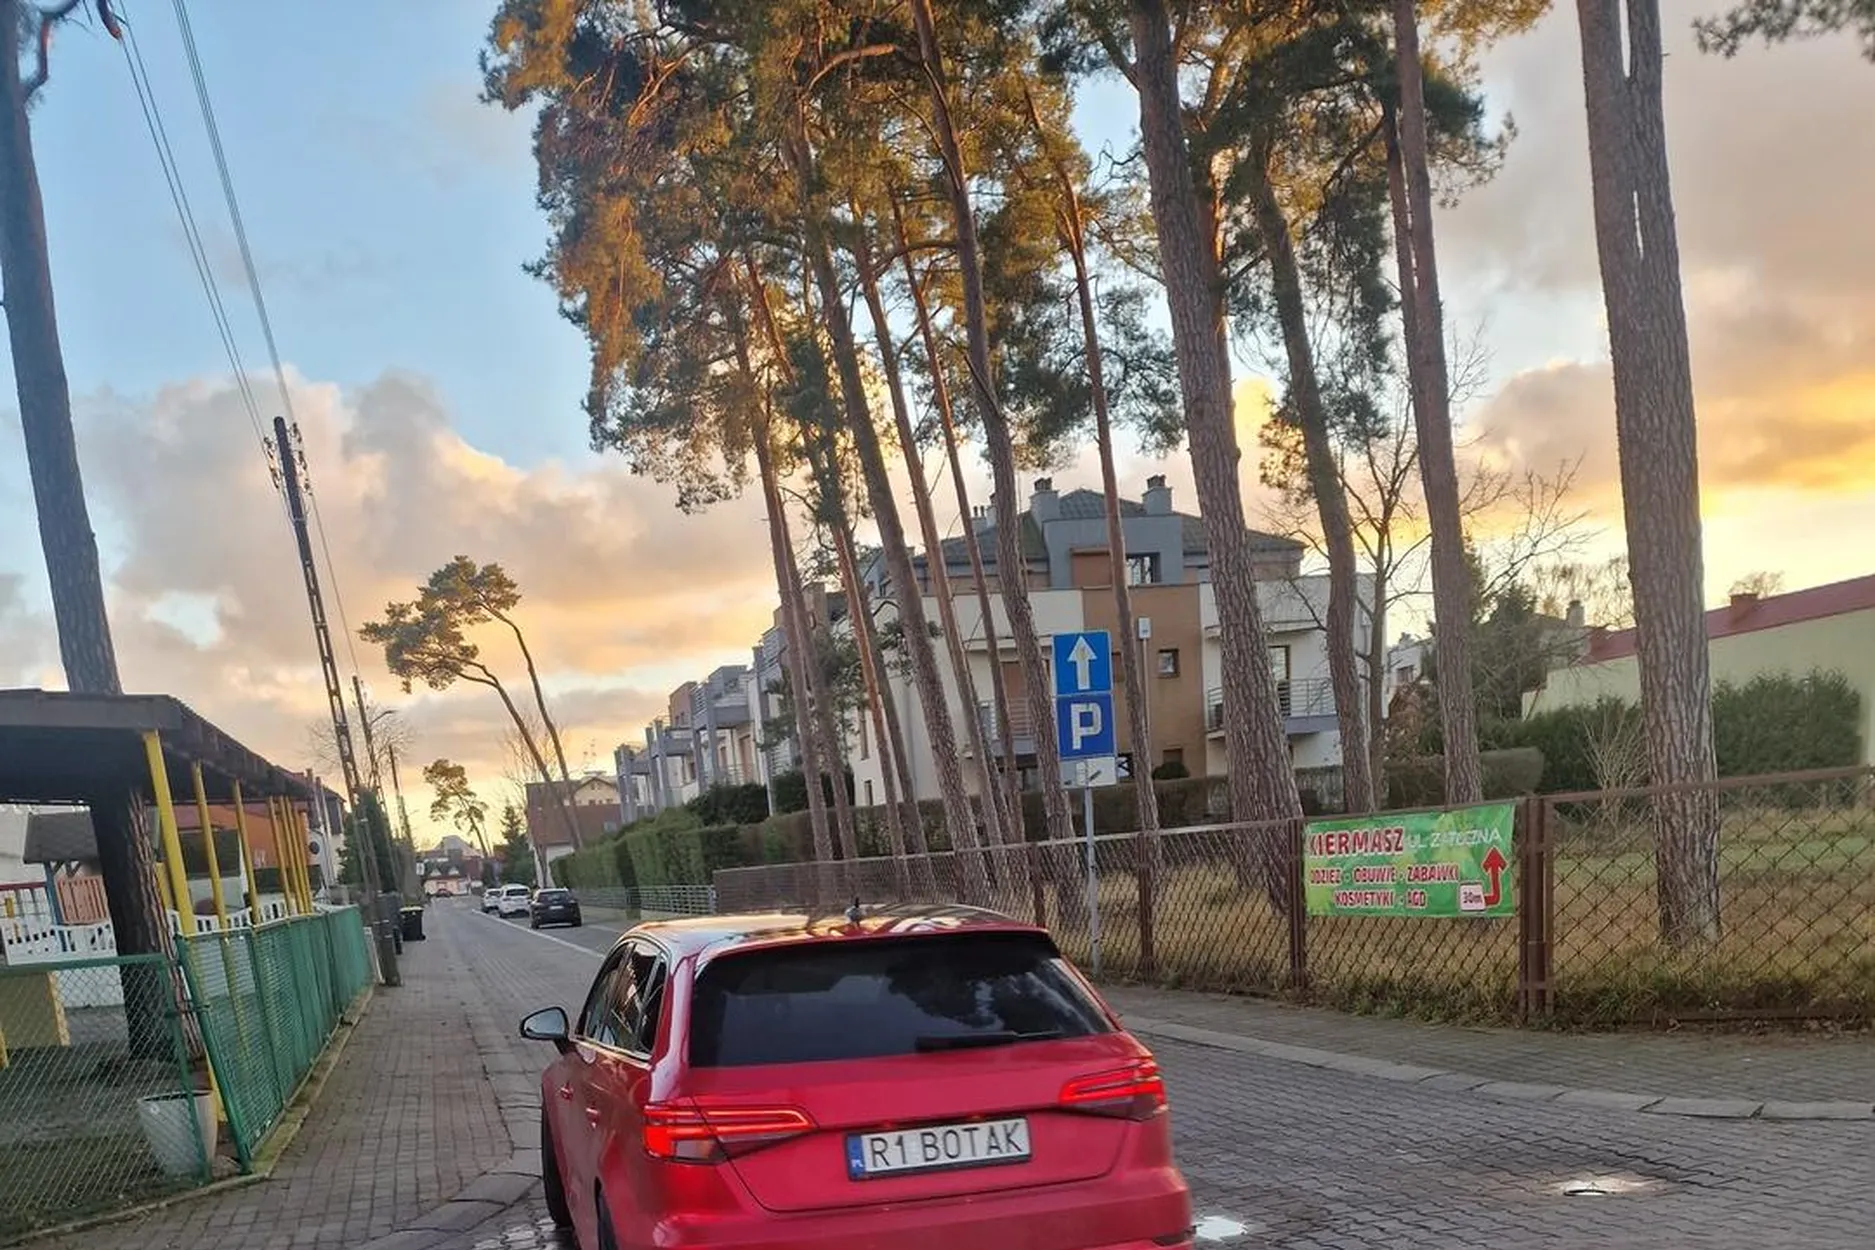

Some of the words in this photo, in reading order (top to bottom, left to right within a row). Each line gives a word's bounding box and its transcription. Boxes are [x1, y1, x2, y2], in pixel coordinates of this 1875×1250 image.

[1070, 702, 1103, 750] P
[1353, 866, 1397, 883] OBUWIE
[1406, 864, 1459, 882] ZABAWKI
[1334, 890, 1395, 907] KOSMETYKI
[870, 1135, 908, 1168] R1
[921, 1122, 1023, 1162] BOTAK
